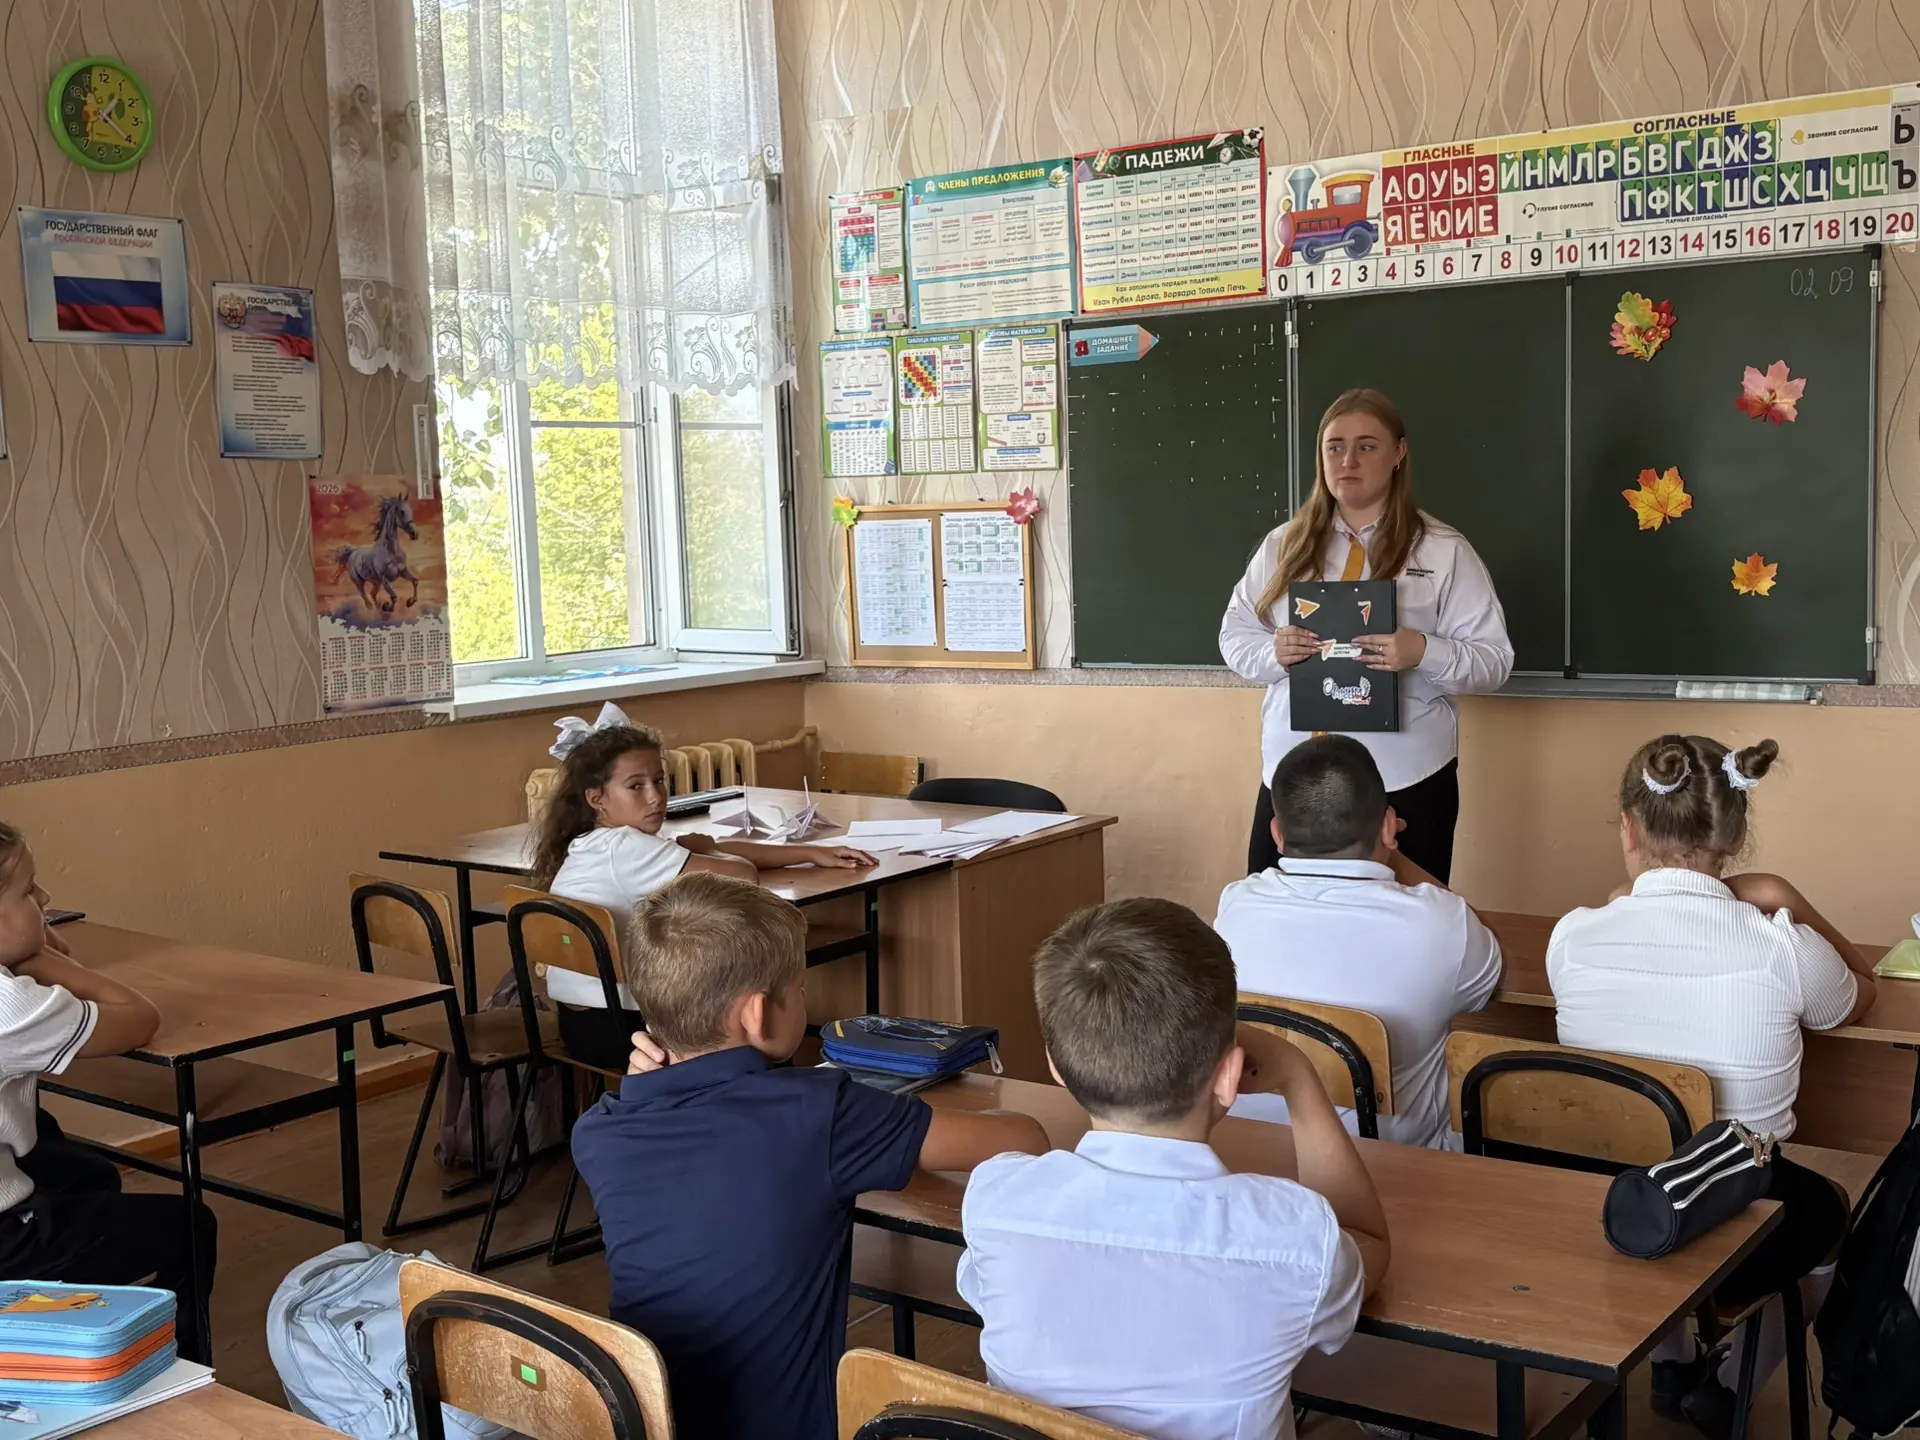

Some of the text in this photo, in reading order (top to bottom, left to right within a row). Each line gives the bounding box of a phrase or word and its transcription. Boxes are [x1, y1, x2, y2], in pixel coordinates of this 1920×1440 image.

[1403, 111, 1736, 163] ГЛАСНЫЕ СОГЛАСНЫЕ
[1838, 125, 1879, 136] СОГЛАСНЫЕ
[1894, 114, 1915, 145] Ь
[1125, 145, 1204, 170] ПАДЕЖИ
[938, 167, 1045, 190] ЧЛЕНЫ ПРЕДЛОЖЕНИЯ
[1891, 160, 1917, 190] Ъ
[1559, 201, 1594, 210] СОГЛАСНЫЕ
[45, 220, 159, 238] ГОСУДАРСТВЕННЫЙ ФЛАГ
[1278, 211, 1914, 291] 0 1 2 3 4 5 6 7 8 9 10 11 12 13 14 15 16 17 18 19 20
[1128, 283, 1160, 292] запомнить
[1161, 281, 1188, 289] порядок
[1791, 266, 1854, 300] 02 09
[1093, 284, 1248, 306] Иван Рубил Дрова, Варвара Топила Печь.
[1091, 335, 1133, 346] ДОМАШНЕЕ
[1096, 344, 1129, 353] ЗАДАНИЕ
